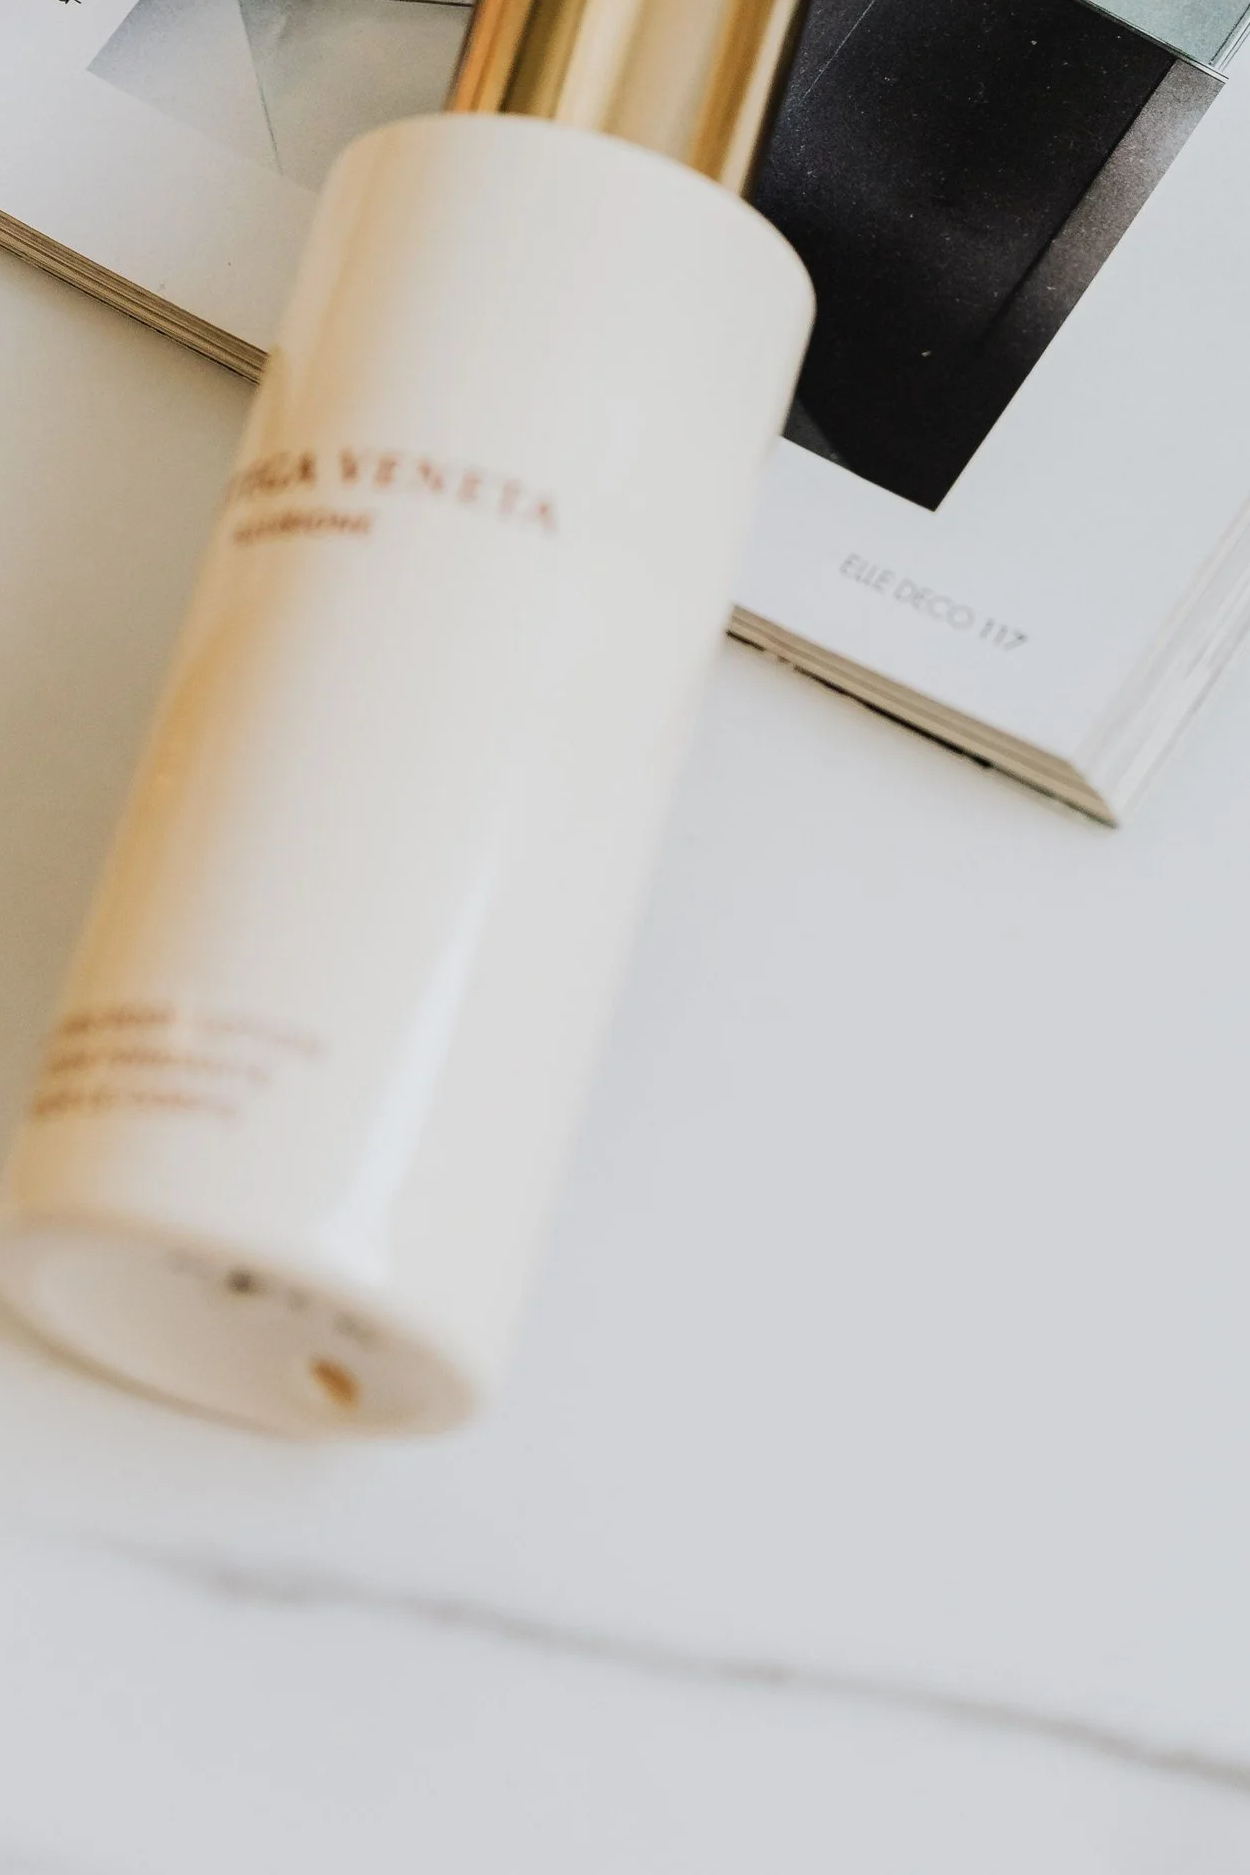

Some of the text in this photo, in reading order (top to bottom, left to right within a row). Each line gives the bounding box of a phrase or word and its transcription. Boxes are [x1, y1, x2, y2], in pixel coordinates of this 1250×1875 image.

[838, 552, 1029, 652] ELLE DECO 117
